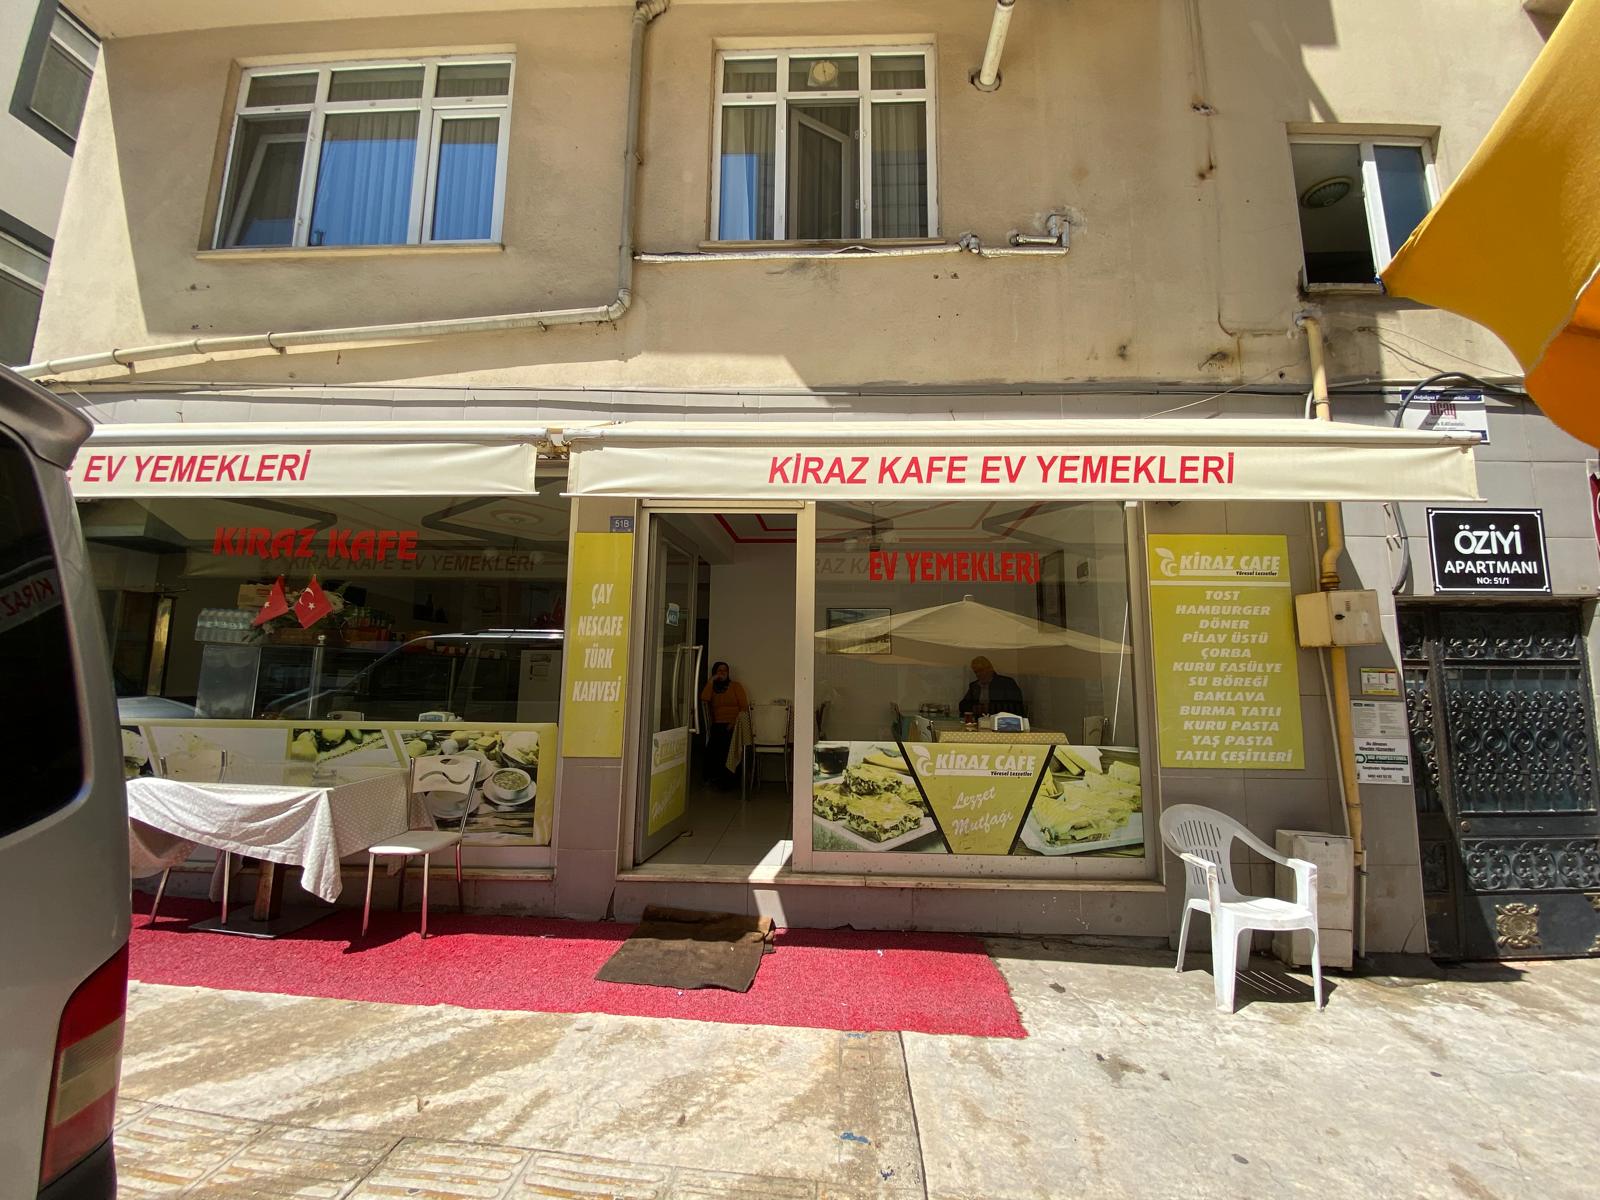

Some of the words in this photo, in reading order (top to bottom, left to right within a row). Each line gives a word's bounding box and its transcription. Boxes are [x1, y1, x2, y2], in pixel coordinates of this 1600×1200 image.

[83, 455, 128, 482] EV
[134, 449, 312, 482] YEMEKLERİ
[768, 452, 870, 484] KİRAZ
[877, 455, 968, 484] KAFE
[980, 455, 1027, 484] EV
[1036, 452, 1235, 484] YEMEKLERİ
[327, 528, 420, 561] KAFE
[1454, 524, 1523, 555] ÖZİYİ
[869, 551, 899, 581] EV
[1179, 552, 1235, 570] KİRAZ
[1239, 555, 1281, 571] CAFE
[1444, 560, 1538, 574] APARTMANI
[1476, 577, 1493, 585] NO:
[1493, 577, 1510, 585] 51/1
[591, 583, 615, 610] ÇAY
[1204, 590, 1241, 601] TOST
[1175, 605, 1271, 616] HAMBURGER
[577, 615, 624, 637] NESCAFE
[1199, 618, 1250, 630] DÖNER
[1182, 631, 1228, 644] PİLAV
[1231, 631, 1270, 644] ÜSTÜ
[583, 644, 614, 669] TÜRK
[1201, 647, 1252, 660] ÇORBA
[1172, 662, 1216, 673] KURU
[1220, 660, 1282, 673] FASÜLYE
[1188, 676, 1209, 687] SU
[1212, 674, 1270, 688] BÖREĞİ
[572, 675, 622, 703] KAHVESİ
[1193, 691, 1266, 702] BAKLAVA
[1180, 705, 1236, 716] BURMA
[1241, 706, 1282, 717] TATLI
[1183, 720, 1227, 731] KURU
[1231, 721, 1280, 732] PASTA
[1192, 735, 1221, 748] YAŞ
[1225, 736, 1273, 747] PASTA
[935, 751, 990, 770] KİRAZ
[995, 755, 1037, 770] CAFE
[1175, 750, 1216, 762] TATLI
[1220, 749, 1293, 764] ÇEŞİTLERİ
[952, 786, 996, 810] Lezzet
